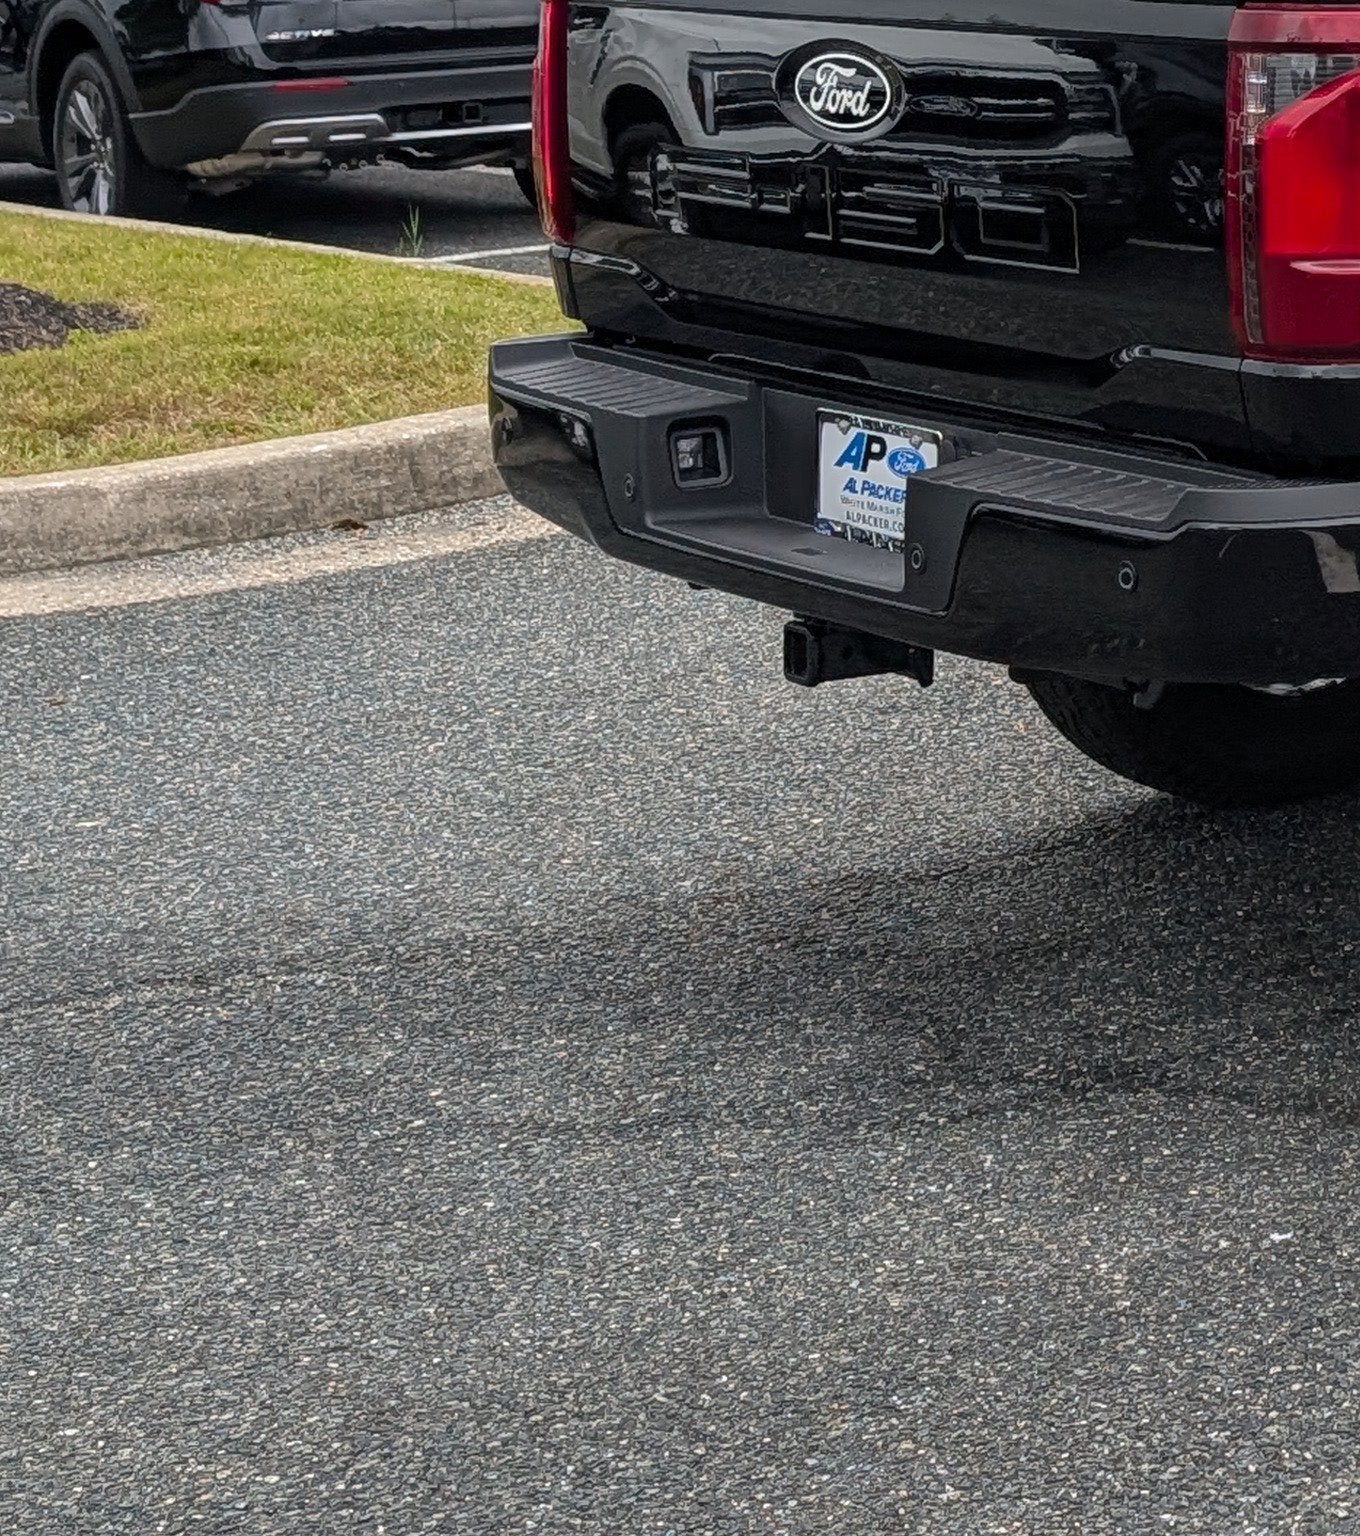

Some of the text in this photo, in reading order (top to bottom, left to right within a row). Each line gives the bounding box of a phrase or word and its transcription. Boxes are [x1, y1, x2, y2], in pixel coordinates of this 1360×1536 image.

[808, 62, 873, 118] Ford
[834, 432, 887, 472] AP
[842, 477, 858, 495] AL
[845, 510, 905, 534] ALPACKER.CO
